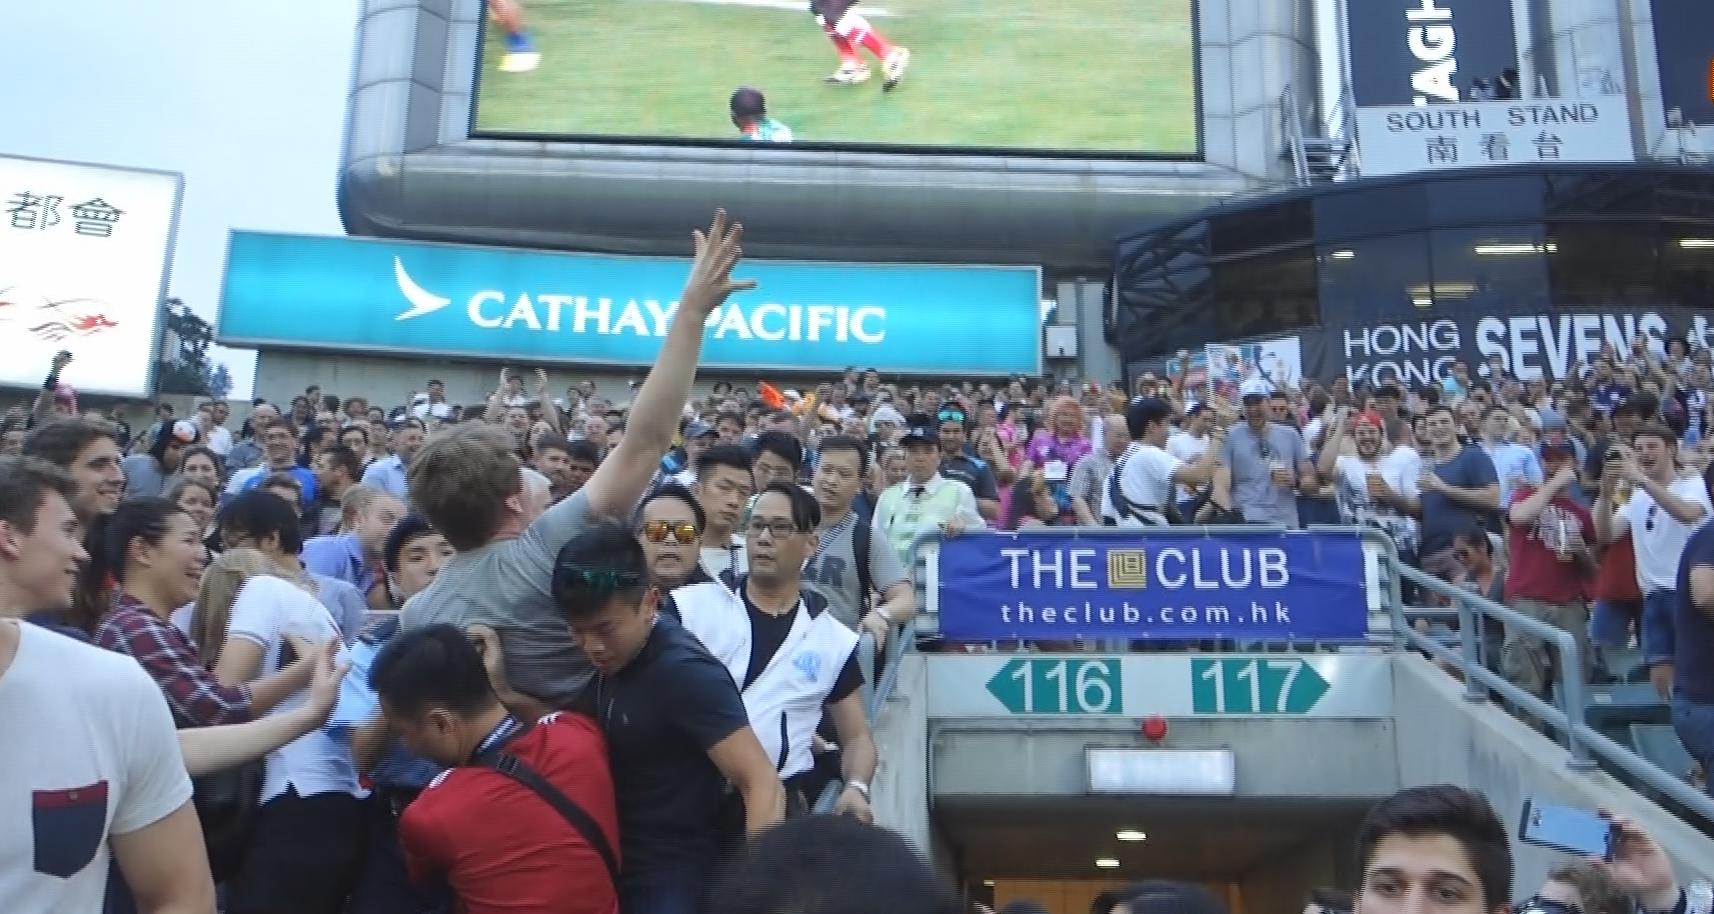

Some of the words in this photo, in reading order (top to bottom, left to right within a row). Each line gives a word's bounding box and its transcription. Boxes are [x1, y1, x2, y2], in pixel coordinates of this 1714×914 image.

[1405, 0, 1460, 107] AGH
[1387, 110, 1481, 132] SOUTH
[1507, 103, 1599, 126] STAND
[1426, 130, 1563, 164] 南看台
[5, 191, 127, 237] 都會
[467, 289, 681, 337] CATHAY
[1344, 319, 1461, 358] HONG
[1001, 549, 1098, 589] THE
[1156, 547, 1291, 589] CLUB
[1001, 602, 1291, 623] theclub.com.hk
[1012, 660, 1112, 713] 116
[1202, 659, 1302, 713] 117
